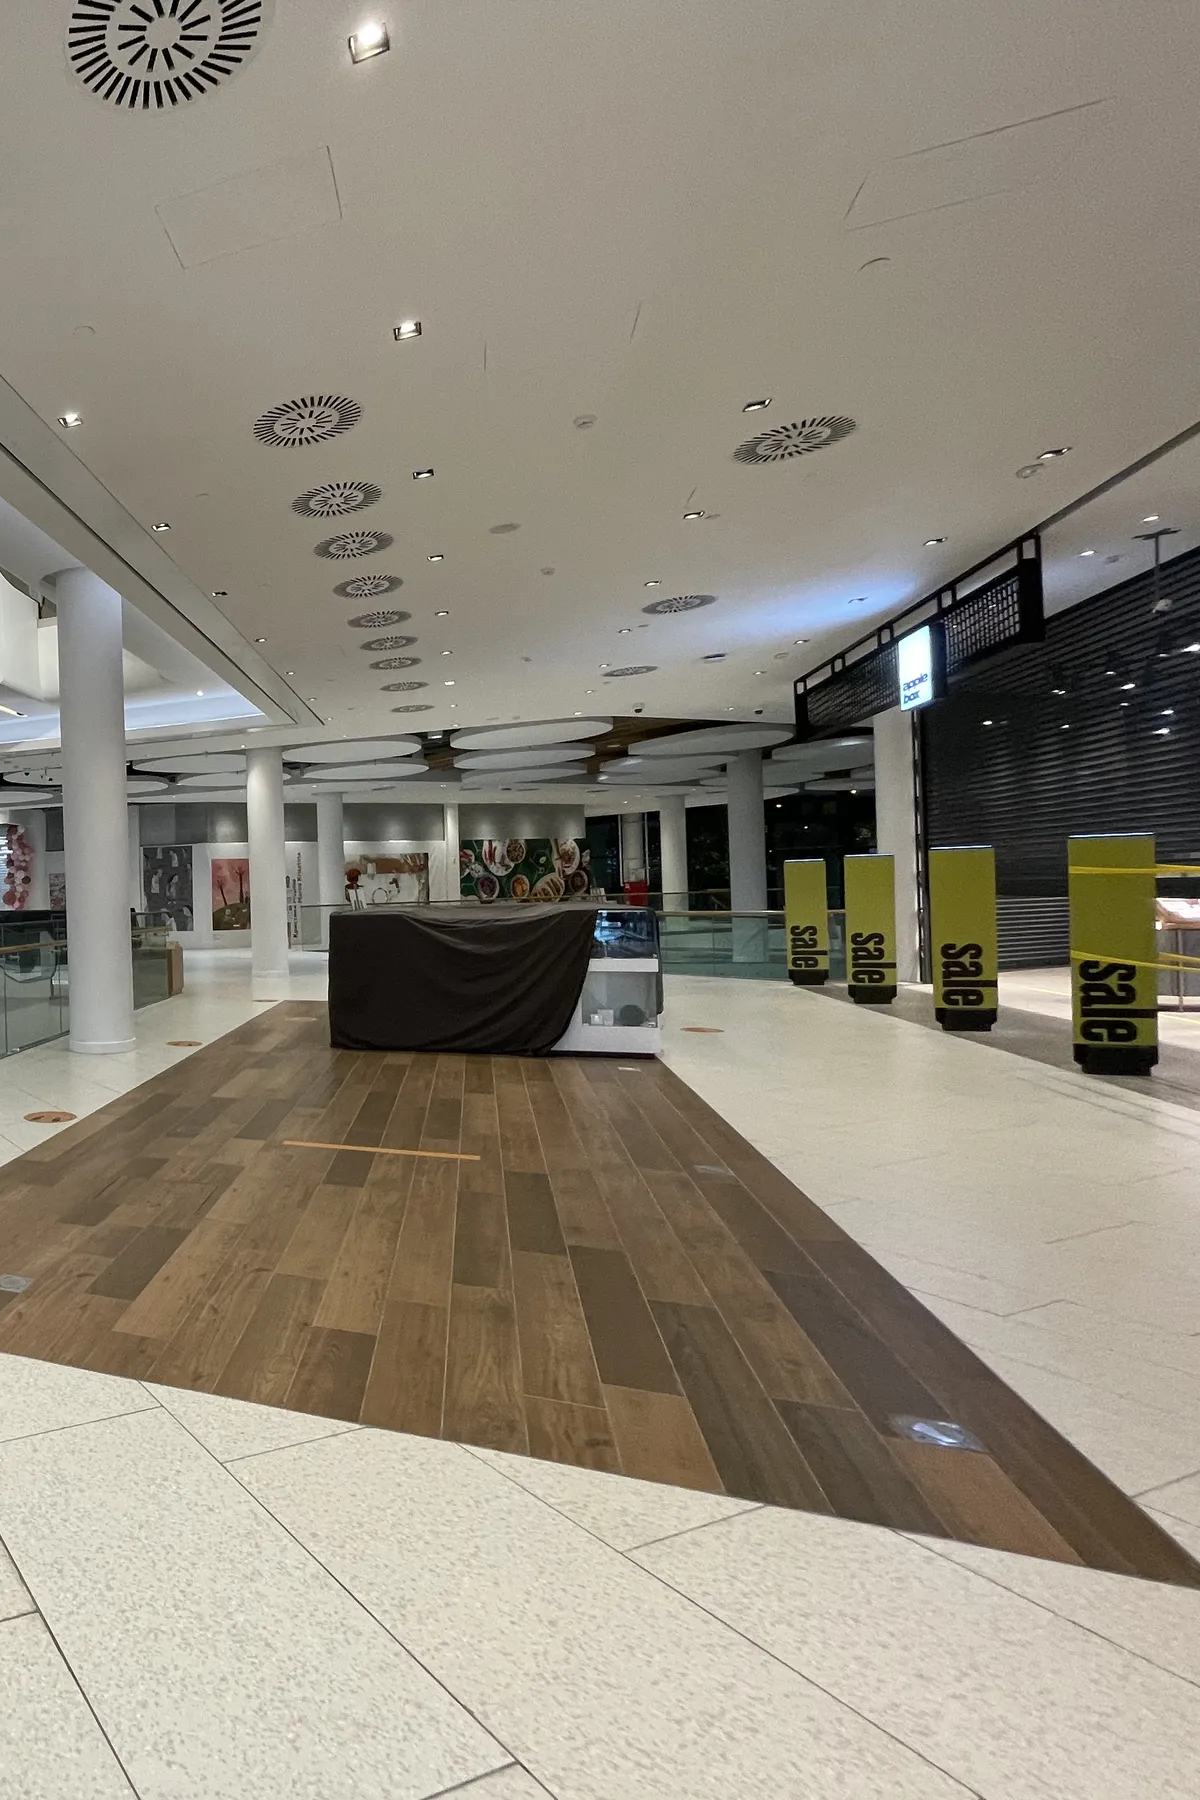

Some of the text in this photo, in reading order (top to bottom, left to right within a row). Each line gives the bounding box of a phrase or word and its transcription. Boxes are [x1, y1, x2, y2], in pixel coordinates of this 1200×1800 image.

[902, 672, 928, 691] apple
[903, 690, 920, 705] box
[790, 925, 828, 969] sale
[850, 932, 897, 984] sale
[940, 943, 997, 1007] sale
[1078, 959, 1158, 1044] sale
